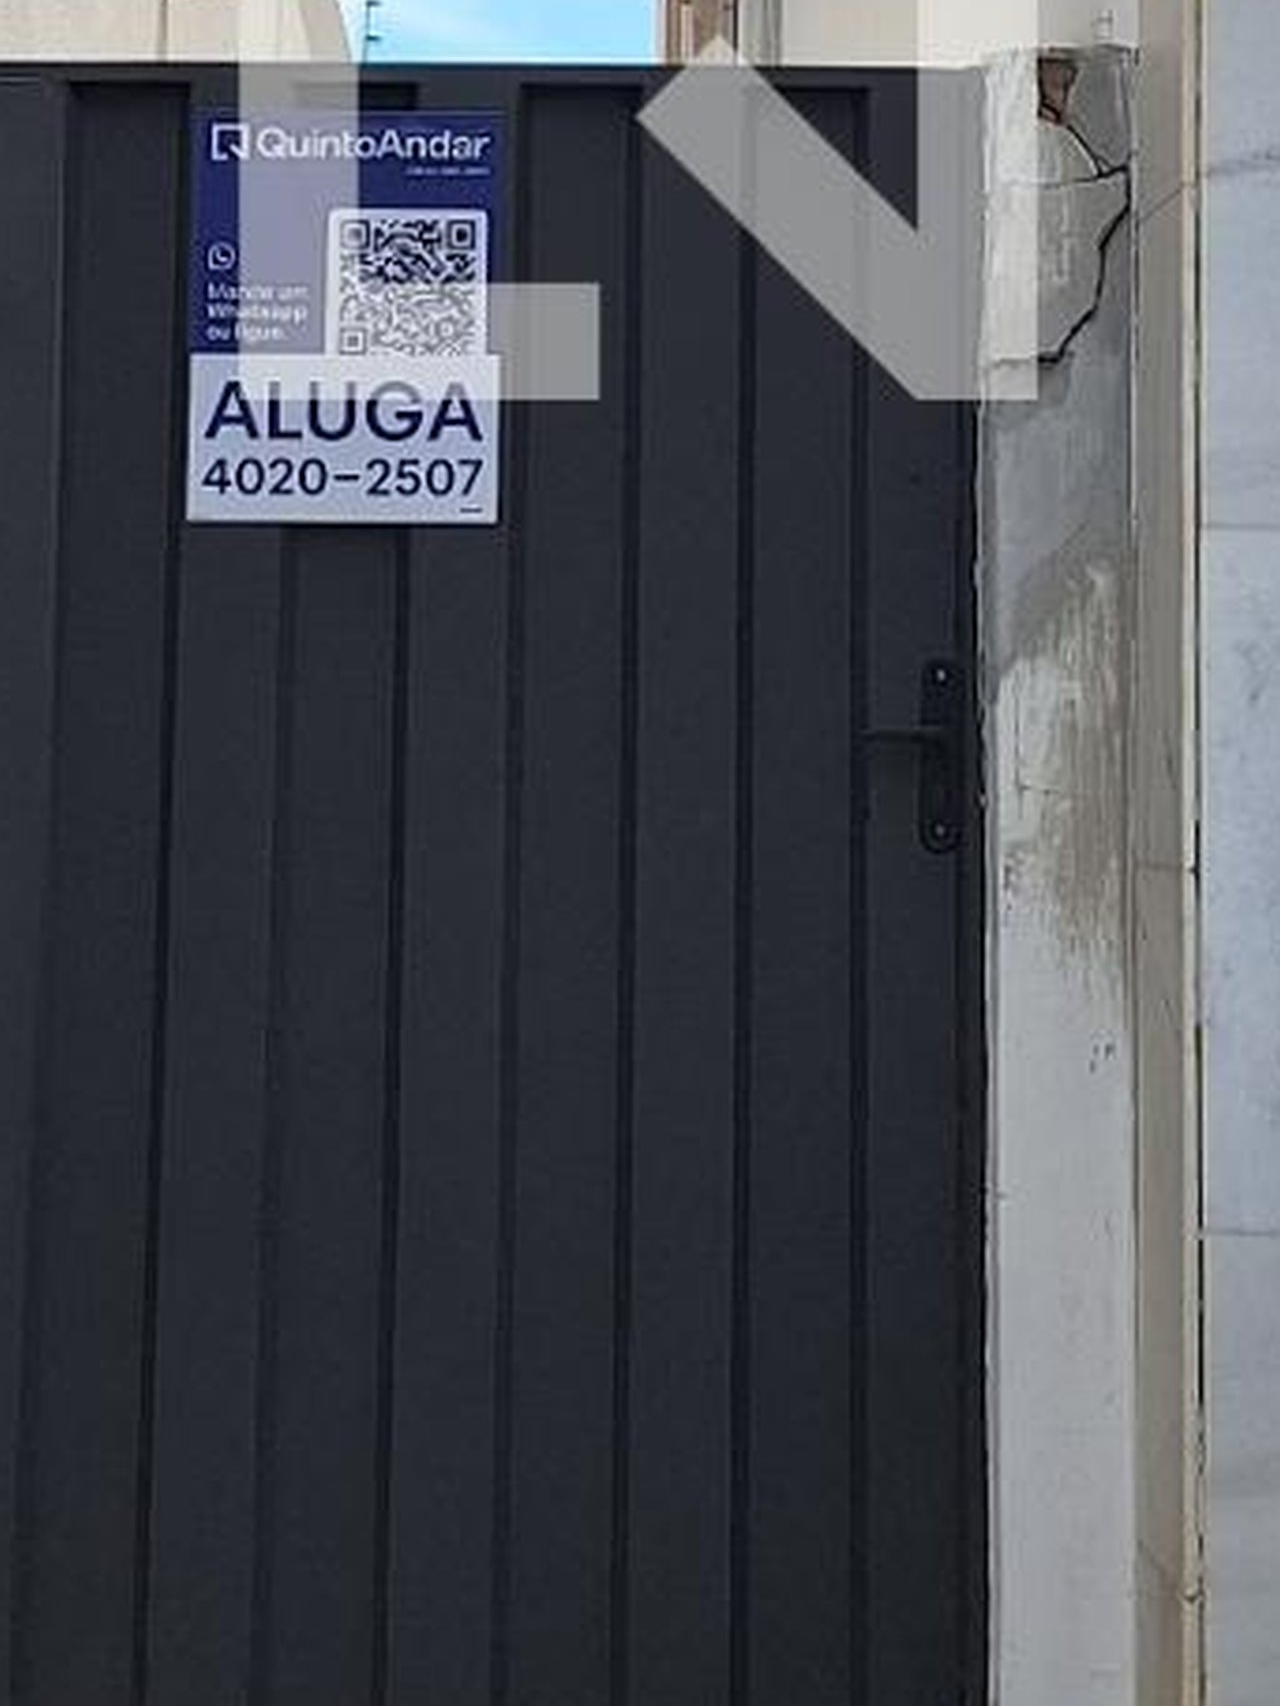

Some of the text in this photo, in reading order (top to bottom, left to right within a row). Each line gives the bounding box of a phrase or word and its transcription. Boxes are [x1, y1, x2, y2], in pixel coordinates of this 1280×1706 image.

[256, 126, 491, 161] QuintoAndar
[204, 379, 485, 443] ALUGA
[202, 457, 485, 497] 4020-2507
